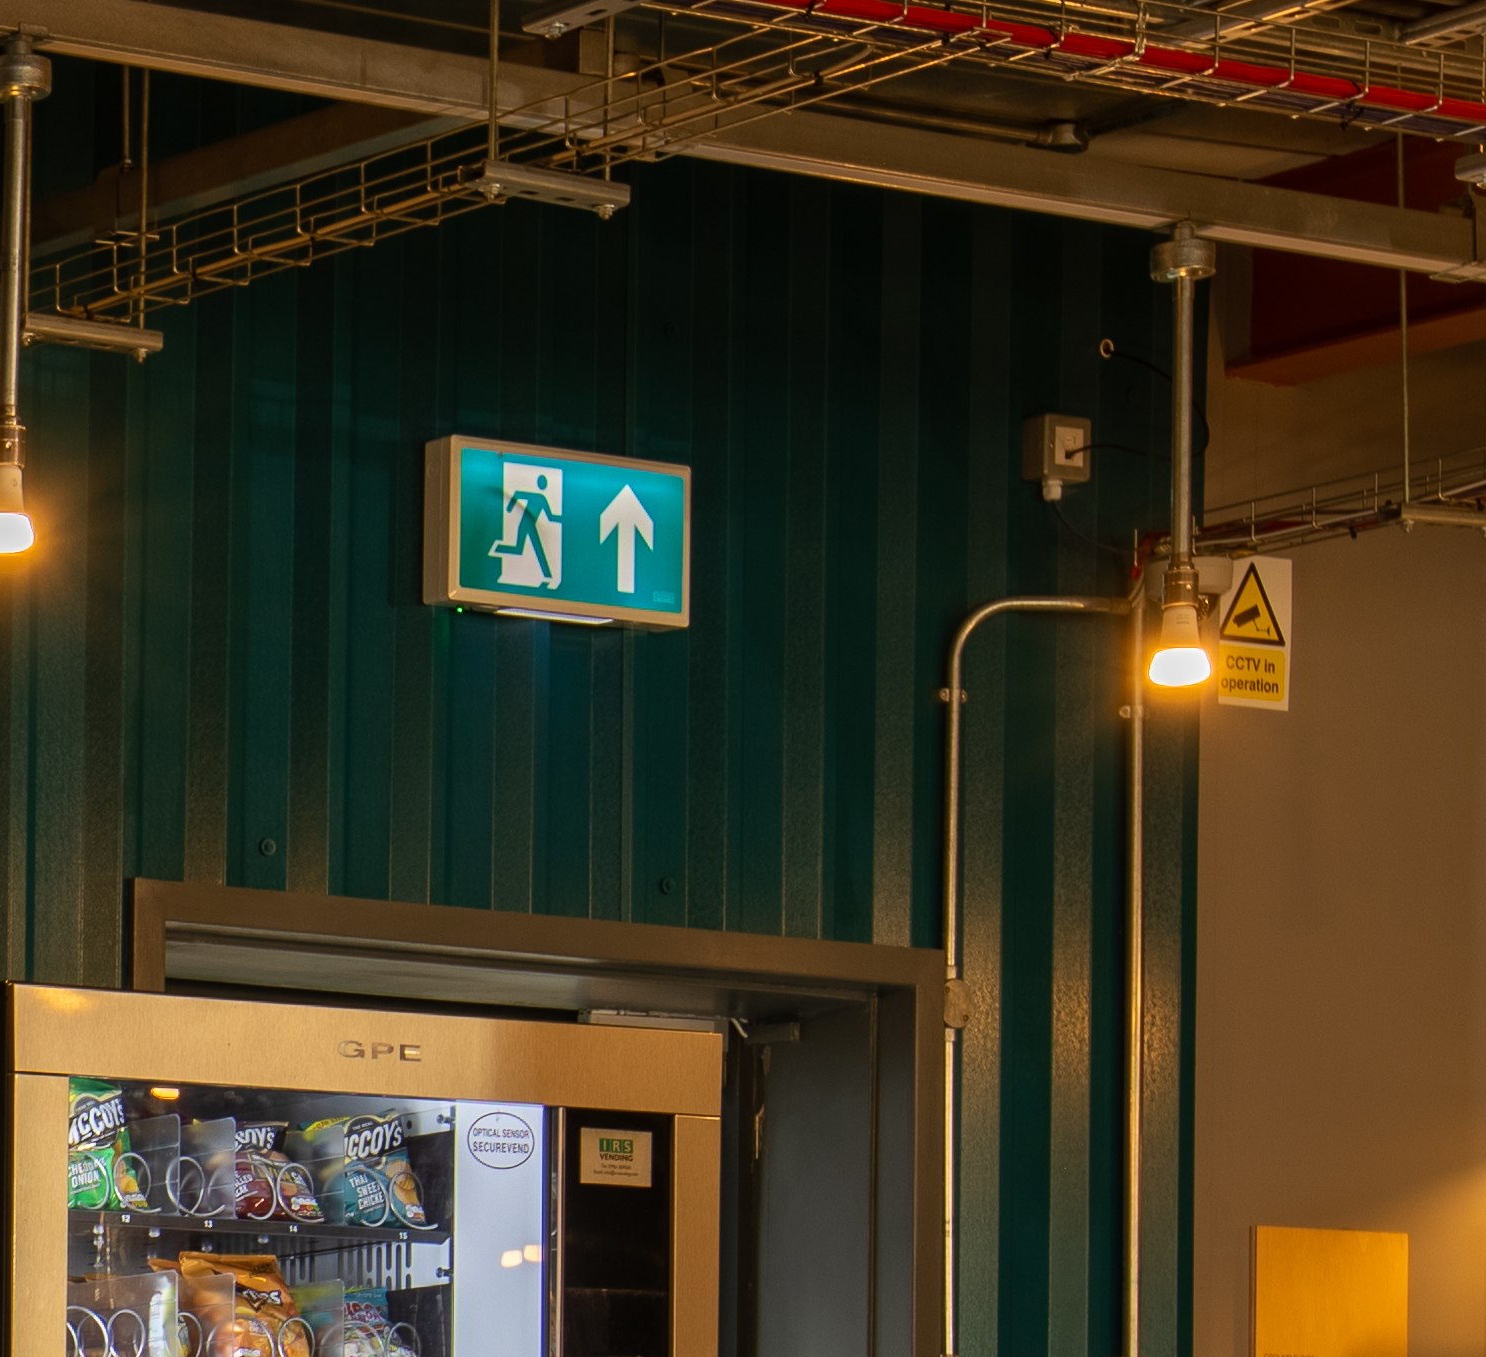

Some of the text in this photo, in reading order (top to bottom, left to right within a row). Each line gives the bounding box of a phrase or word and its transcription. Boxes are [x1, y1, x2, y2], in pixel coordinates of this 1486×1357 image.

[1226, 655, 1275, 674] CCTV in
[1221, 677, 1279, 694] operation
[337, 1040, 422, 1062] GPE
[473, 1127, 530, 1139] OPTICAL SENSOR
[472, 1141, 530, 1154] SECUREVEND
[601, 1139, 633, 1153] IRS
[600, 1153, 634, 1162] VENDING
[71, 1170, 99, 1188] ONION
[349, 1174, 368, 1189] THAI
[356, 1180, 381, 1197] SWEE
[358, 1194, 384, 1210] CHICKE
